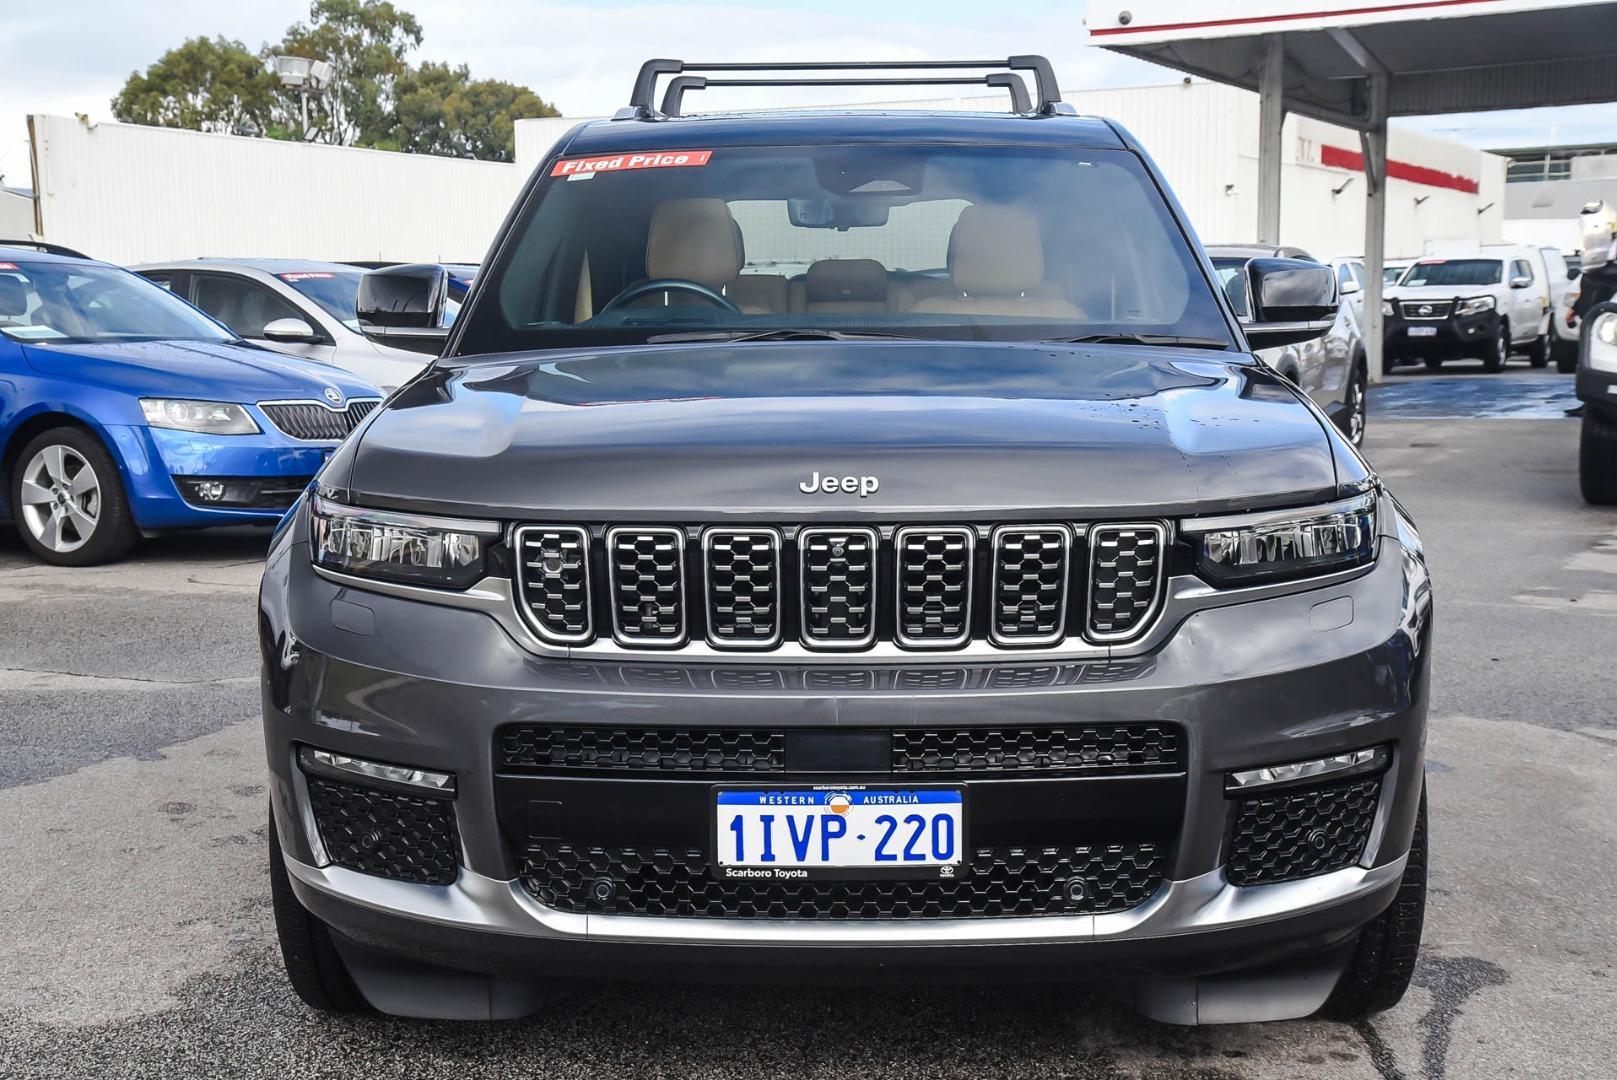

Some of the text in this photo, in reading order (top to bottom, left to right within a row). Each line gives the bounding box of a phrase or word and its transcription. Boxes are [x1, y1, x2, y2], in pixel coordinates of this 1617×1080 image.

[561, 154, 689, 174] Fixed Price
[799, 472, 879, 497] Jeep
[759, 795, 919, 805] WESTERN AUSTRALIA
[726, 868, 808, 879] Scarboro Toyota
